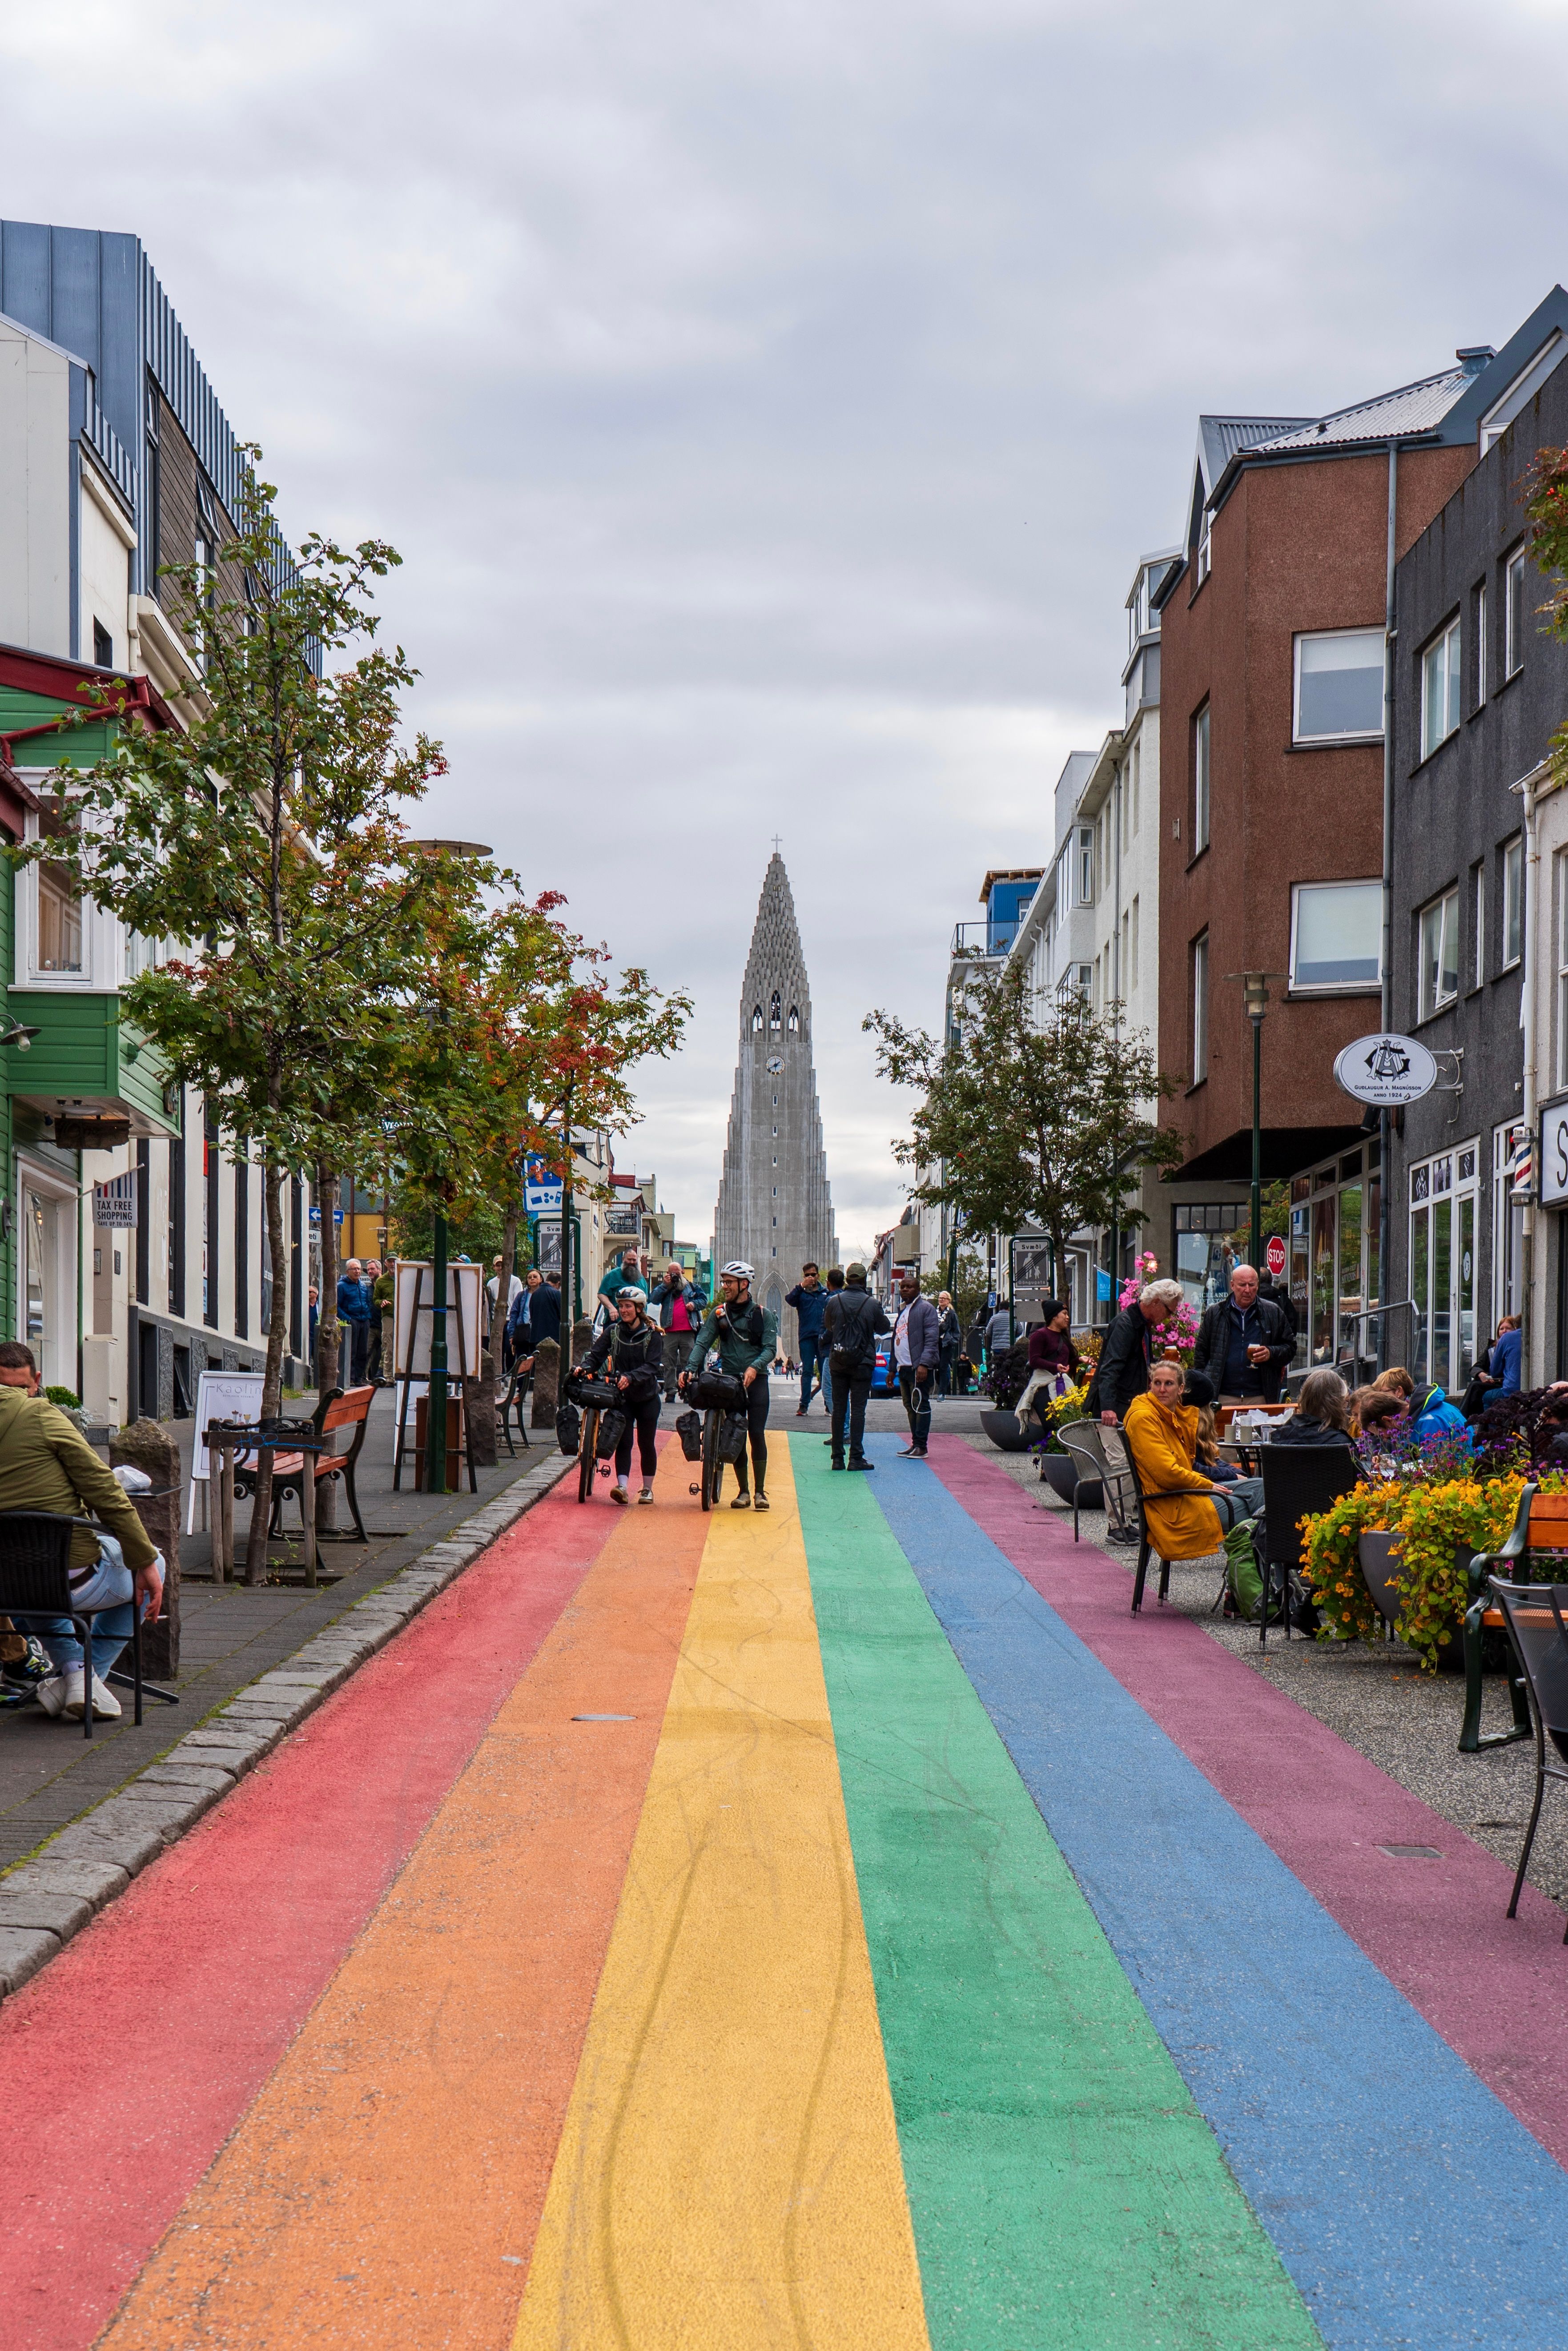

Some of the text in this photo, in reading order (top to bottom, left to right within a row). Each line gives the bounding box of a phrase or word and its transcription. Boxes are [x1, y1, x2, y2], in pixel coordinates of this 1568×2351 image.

[96, 1200, 133, 1211] TAX FREE
[97, 1211, 133, 1221] SHOPPING
[1268, 1248, 1284, 1264] STOP
[216, 1383, 261, 1394] Kaolin
